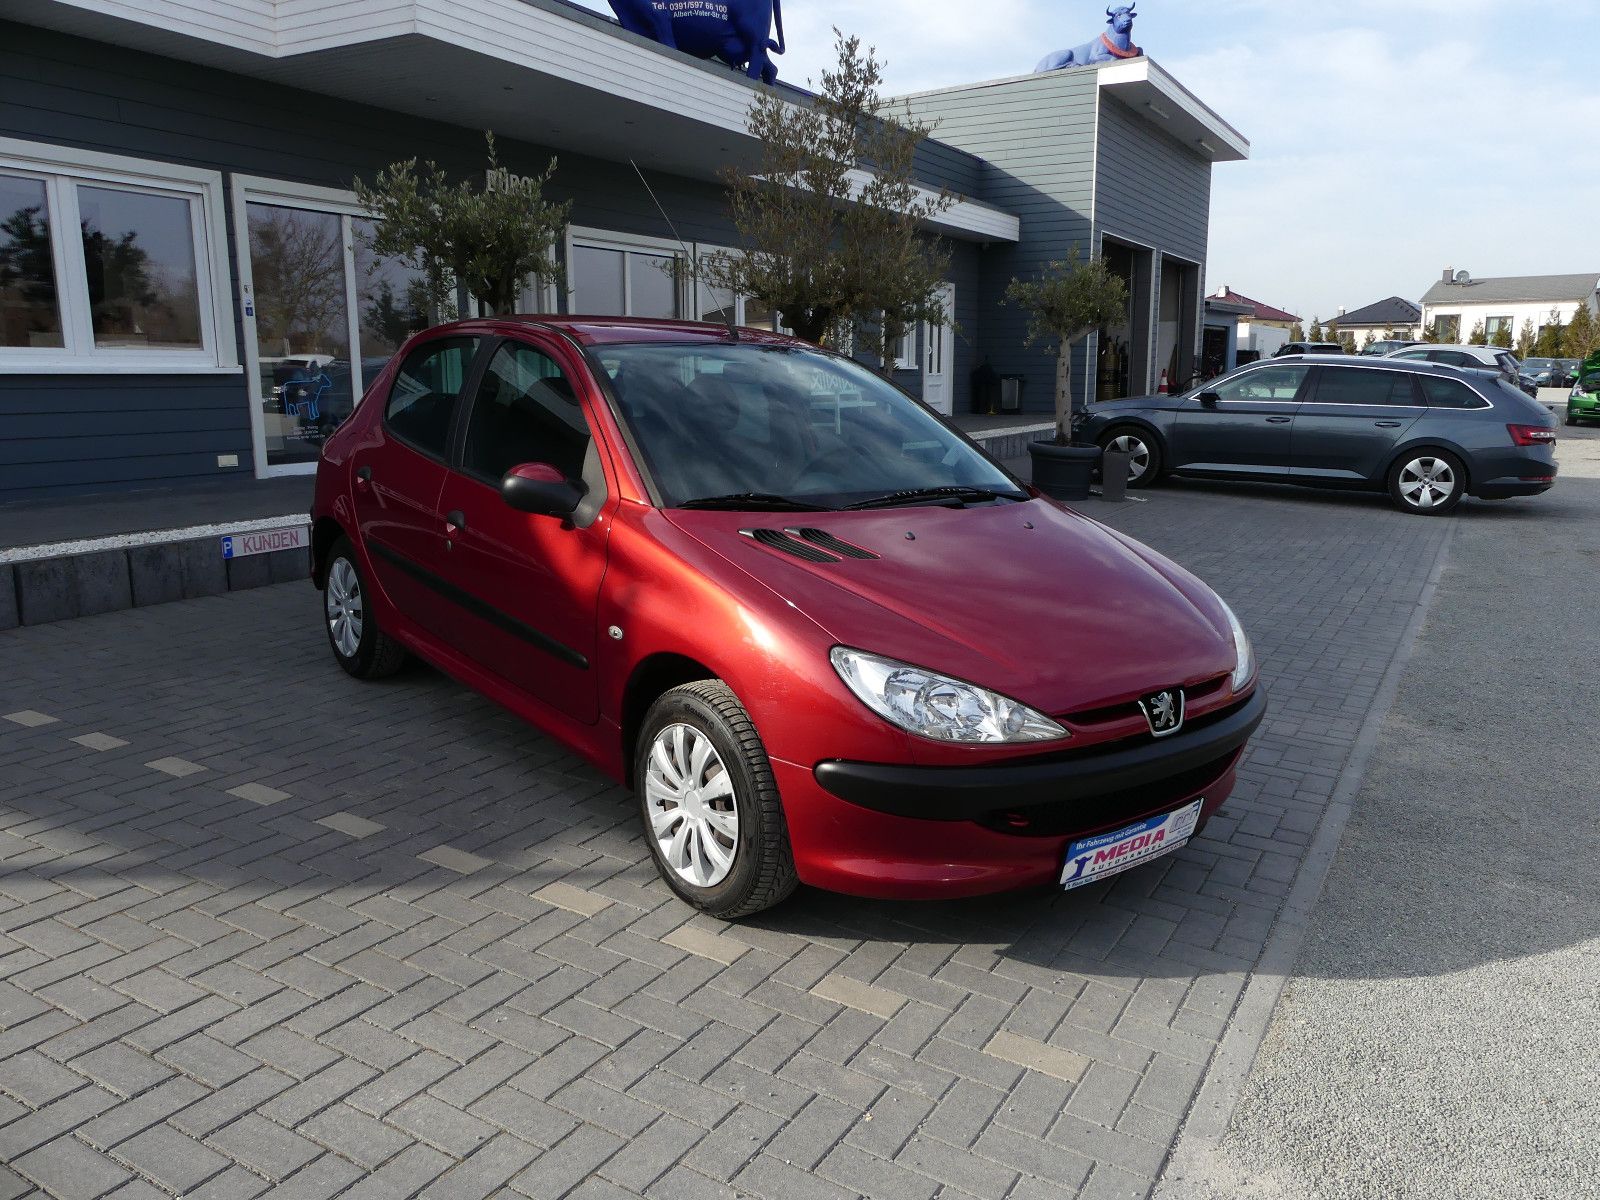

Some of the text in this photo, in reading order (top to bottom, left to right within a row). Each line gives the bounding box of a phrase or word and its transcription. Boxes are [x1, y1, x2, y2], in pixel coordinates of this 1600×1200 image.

[652, 2, 667, 10] Tel.
[669, 1, 704, 11] 0391/597
[715, 4, 728, 13] 100
[242, 531, 299, 553] KUNDEN
[1076, 822, 1147, 850] Ihr Fahrzeug mit Garantie
[1093, 828, 1165, 865] MEDIA
[1090, 843, 1162, 873] AUTOHANDEL
